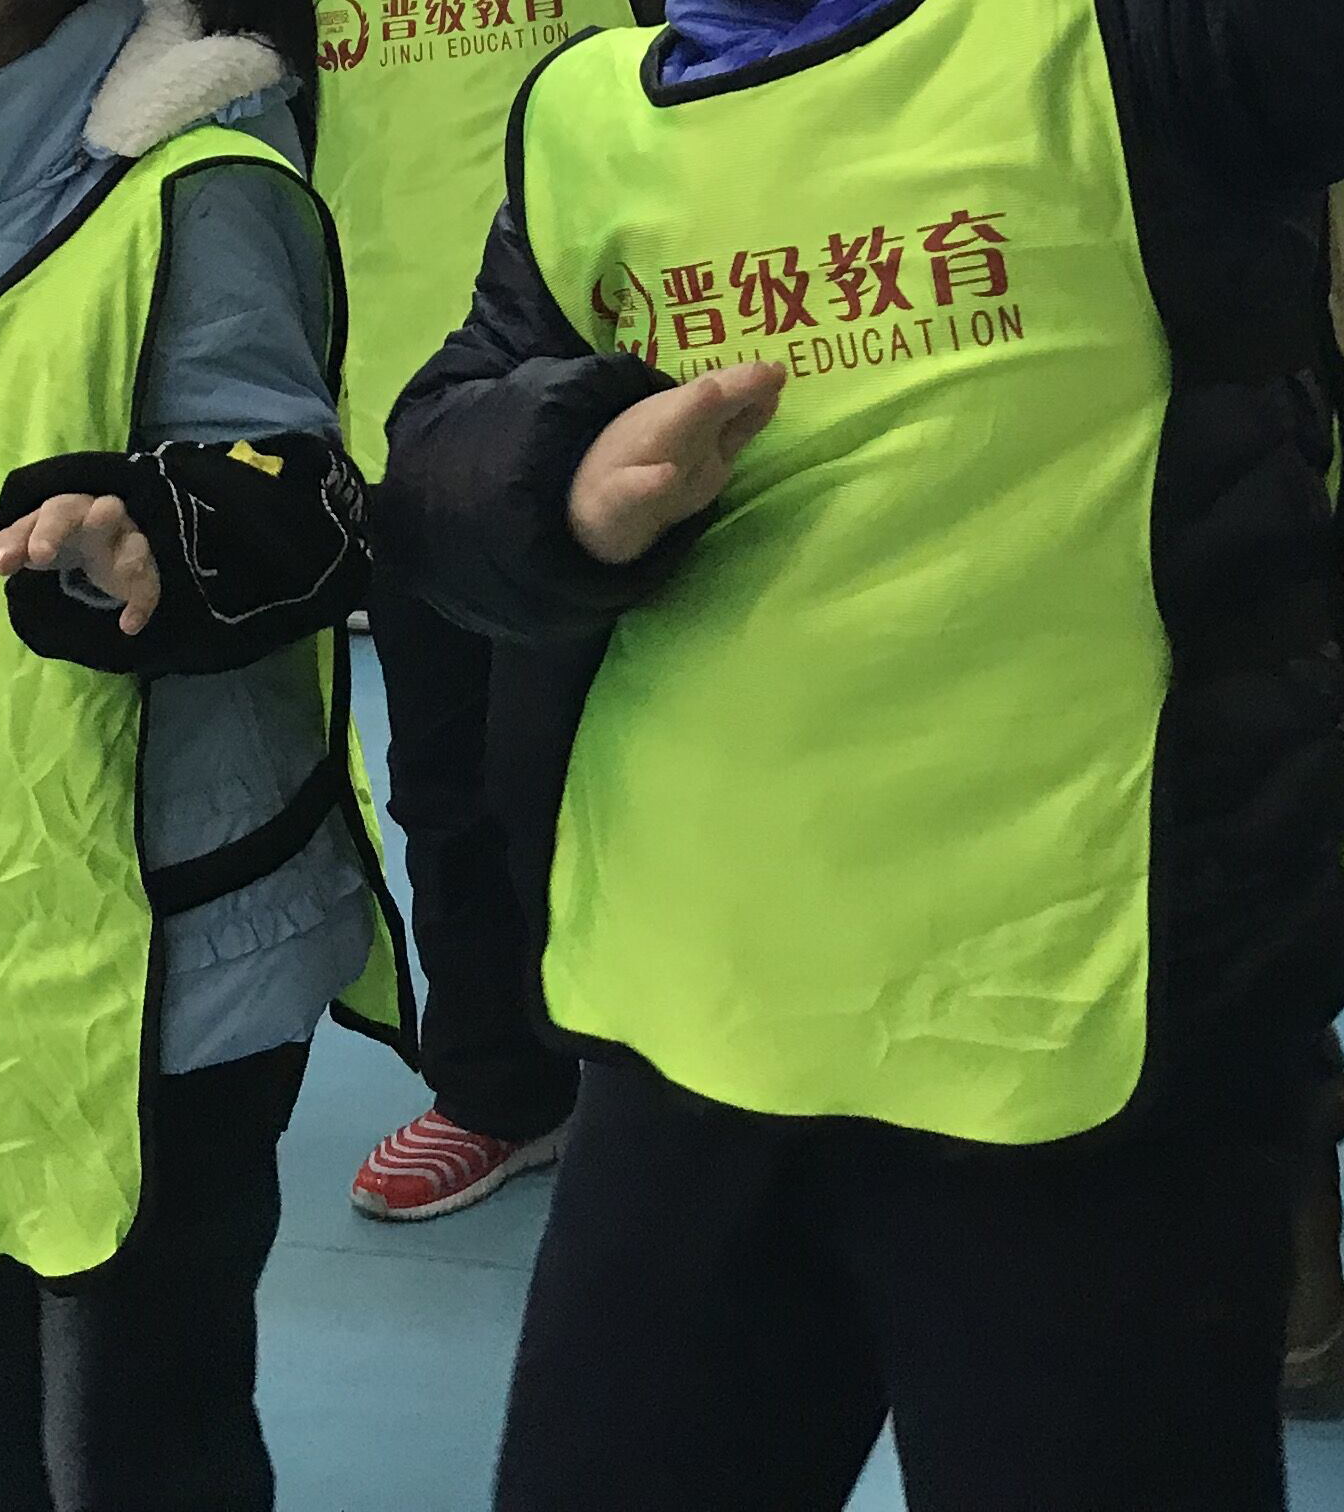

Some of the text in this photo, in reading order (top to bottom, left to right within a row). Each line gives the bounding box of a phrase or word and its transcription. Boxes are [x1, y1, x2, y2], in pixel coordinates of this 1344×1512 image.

[379, 20, 570, 68] JINJI EDUCATION
[660, 209, 1012, 351] 晋级教育
[788, 303, 1026, 379] EDUCATION
